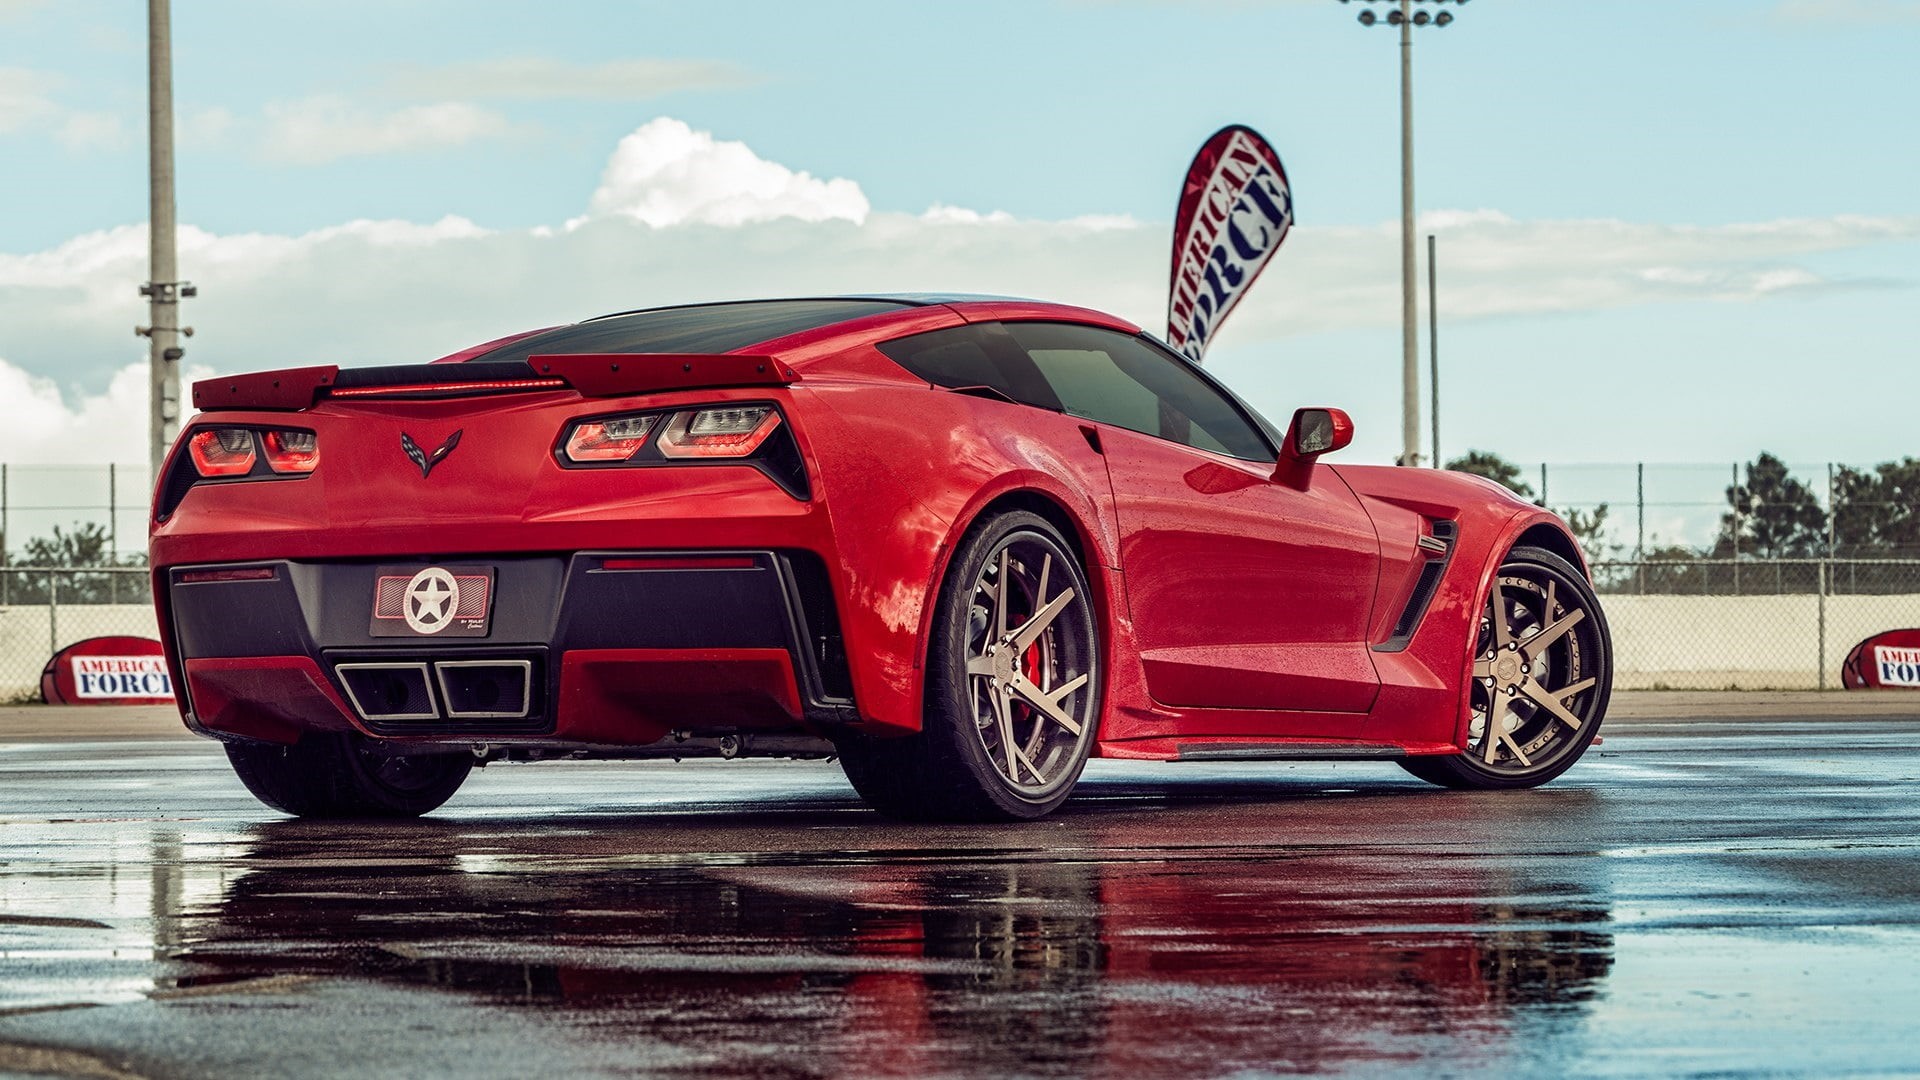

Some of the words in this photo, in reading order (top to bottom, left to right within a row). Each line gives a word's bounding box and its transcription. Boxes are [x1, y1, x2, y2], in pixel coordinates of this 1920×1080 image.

[1169, 136, 1259, 349] AMERICAN
[80, 660, 166, 672] AMERICA
[1882, 663, 1920, 682] FO
